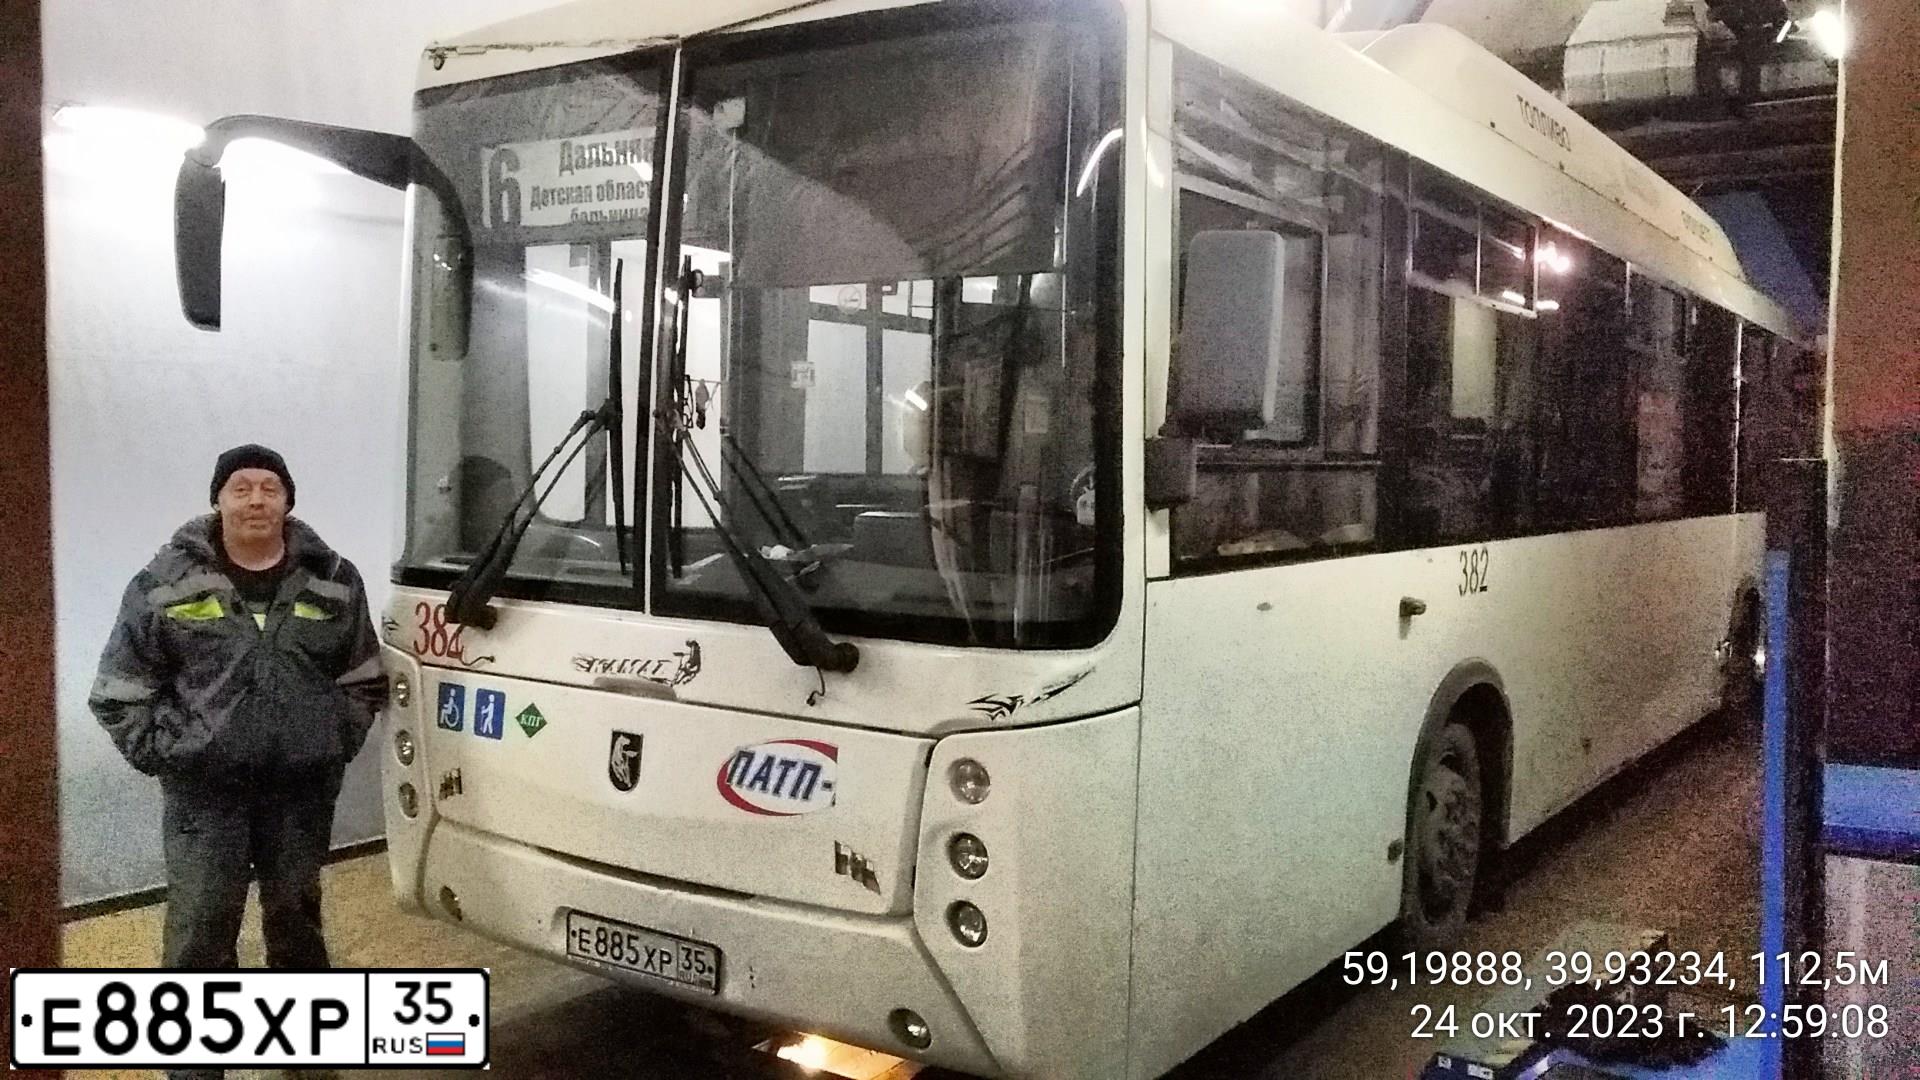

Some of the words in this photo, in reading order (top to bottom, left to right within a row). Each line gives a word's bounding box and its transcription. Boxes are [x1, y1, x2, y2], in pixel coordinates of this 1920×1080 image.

[1516, 94, 1572, 152] ТОПЛИВО
[489, 147, 521, 225] 6
[530, 185, 593, 211] Детская
[596, 179, 651, 202] област
[1458, 546, 1488, 596] 382
[520, 713, 545, 727] КПГ
[726, 750, 836, 807] ПАТП-
[578, 927, 672, 973] Е885ХР
[681, 946, 706, 974] 35
